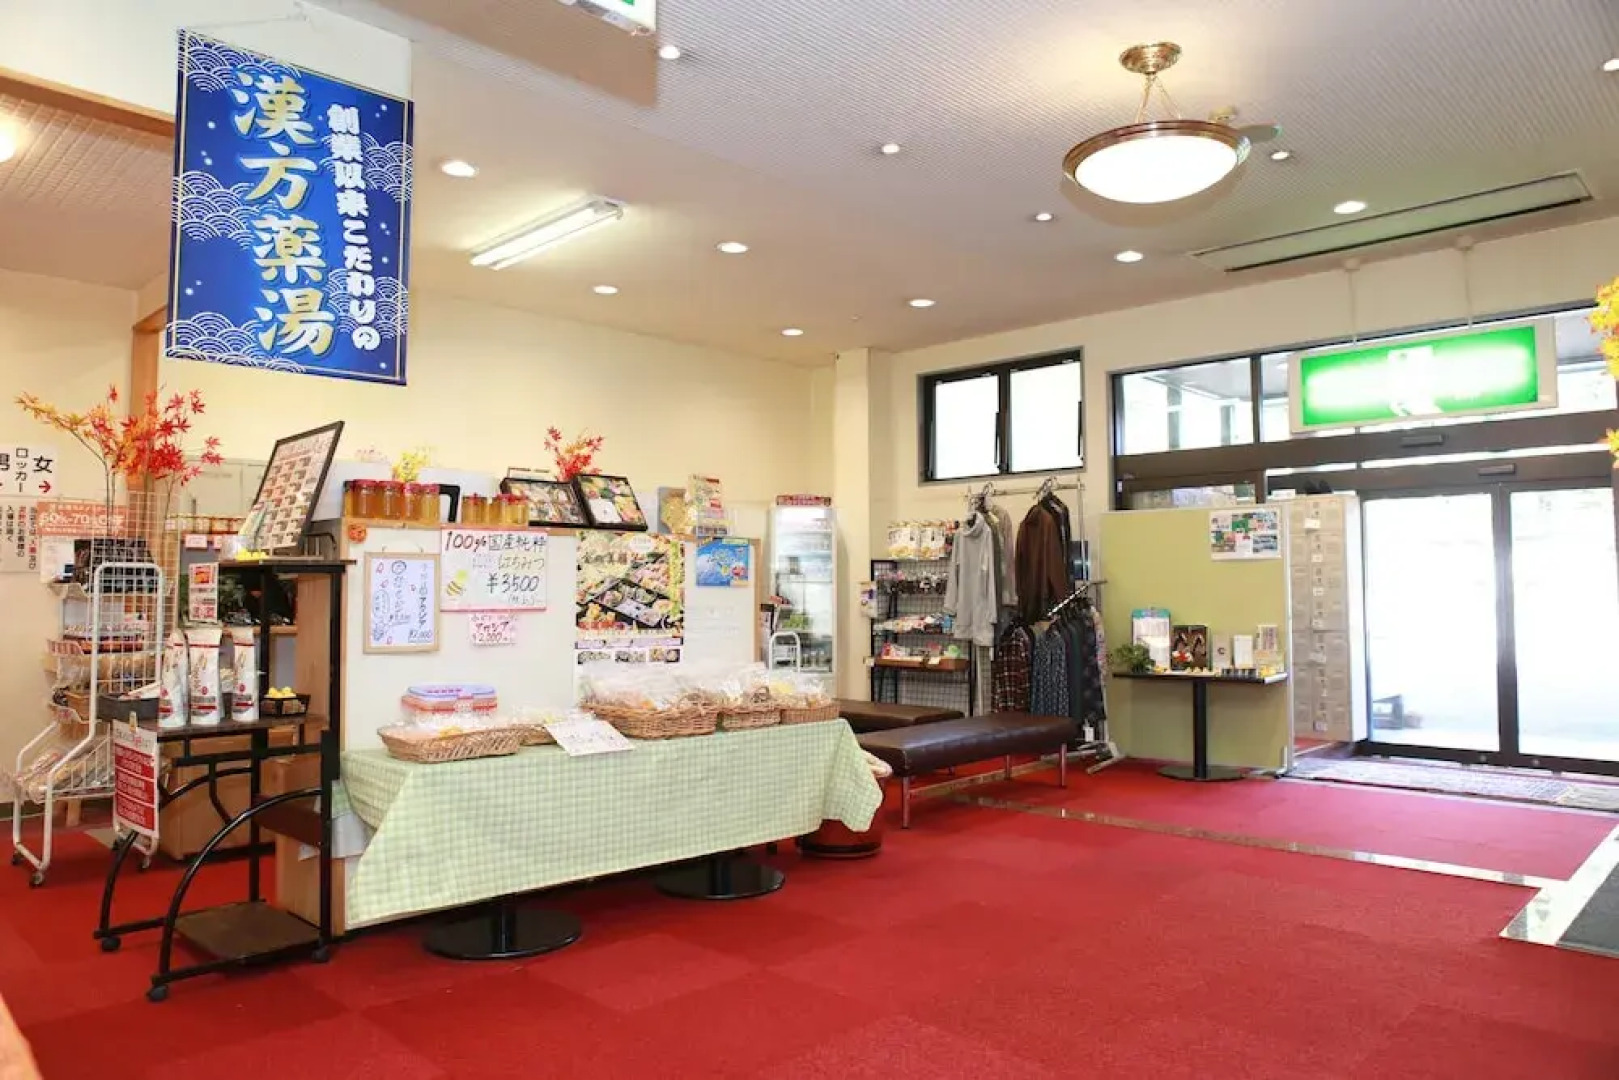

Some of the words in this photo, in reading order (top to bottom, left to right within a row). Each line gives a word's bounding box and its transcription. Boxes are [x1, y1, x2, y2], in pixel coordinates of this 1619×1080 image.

[232, 71, 336, 357] 漢方薬湯
[326, 103, 381, 351] 創業以来こだわりの
[15, 447, 29, 492] ロッカー
[33, 454, 53, 474] 女
[486, 572, 540, 594] ¥3500
